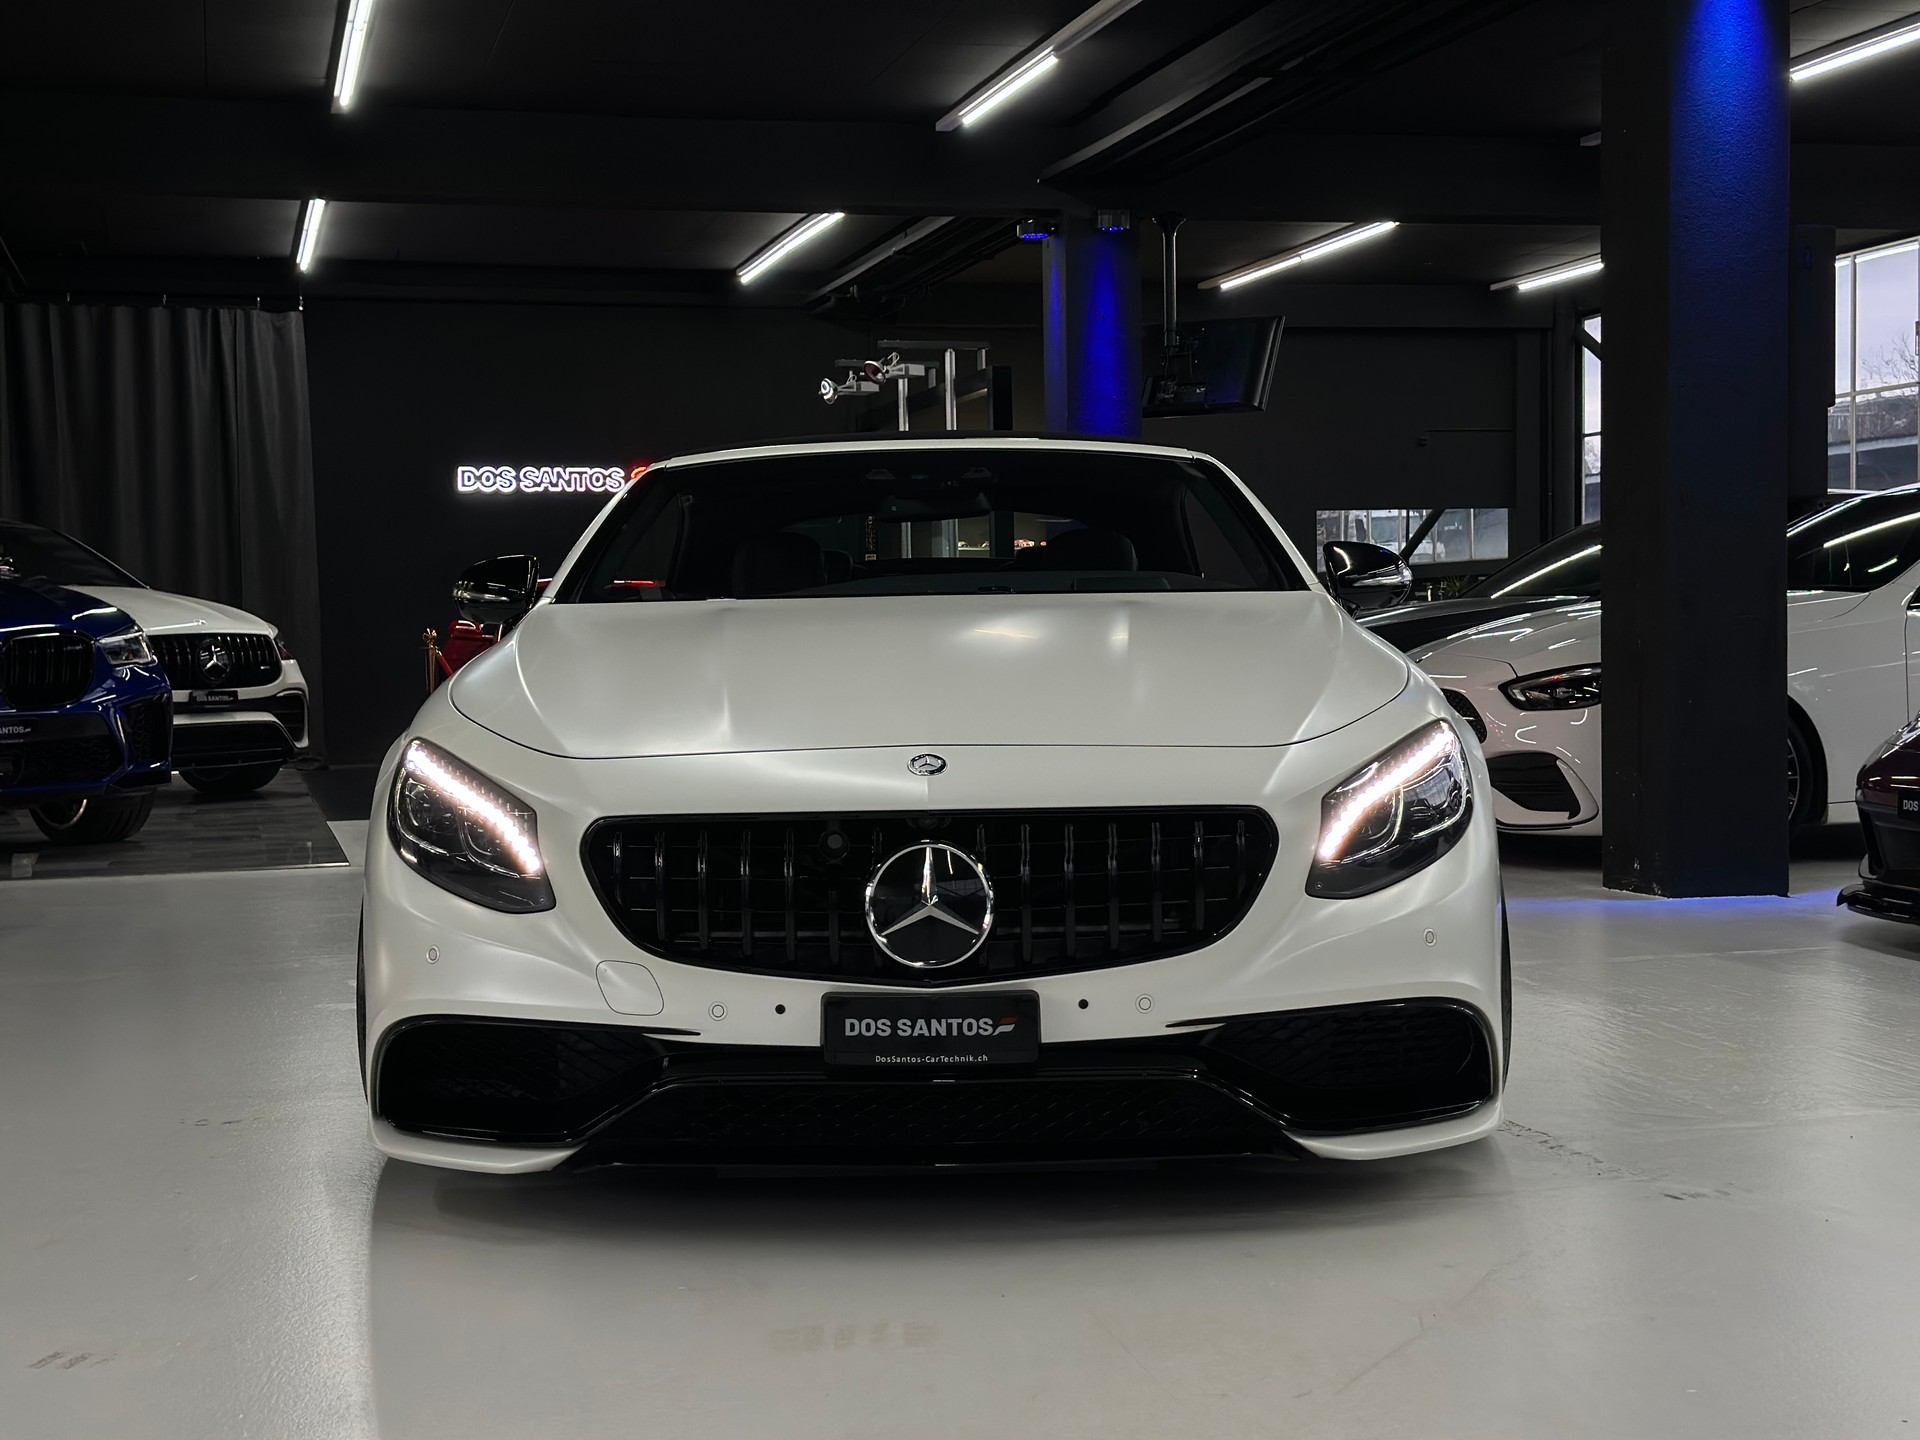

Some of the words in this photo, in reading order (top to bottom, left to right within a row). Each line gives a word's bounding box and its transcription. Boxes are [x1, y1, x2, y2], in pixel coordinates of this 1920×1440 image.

[457, 466, 516, 492] DOS
[519, 466, 625, 492] SANTOS
[1903, 800, 1919, 811] DOS
[845, 1018, 891, 1036] DOS
[897, 1018, 994, 1036] SANTOS
[875, 1055, 988, 1063] DosSantos-CarTechnik.ch
